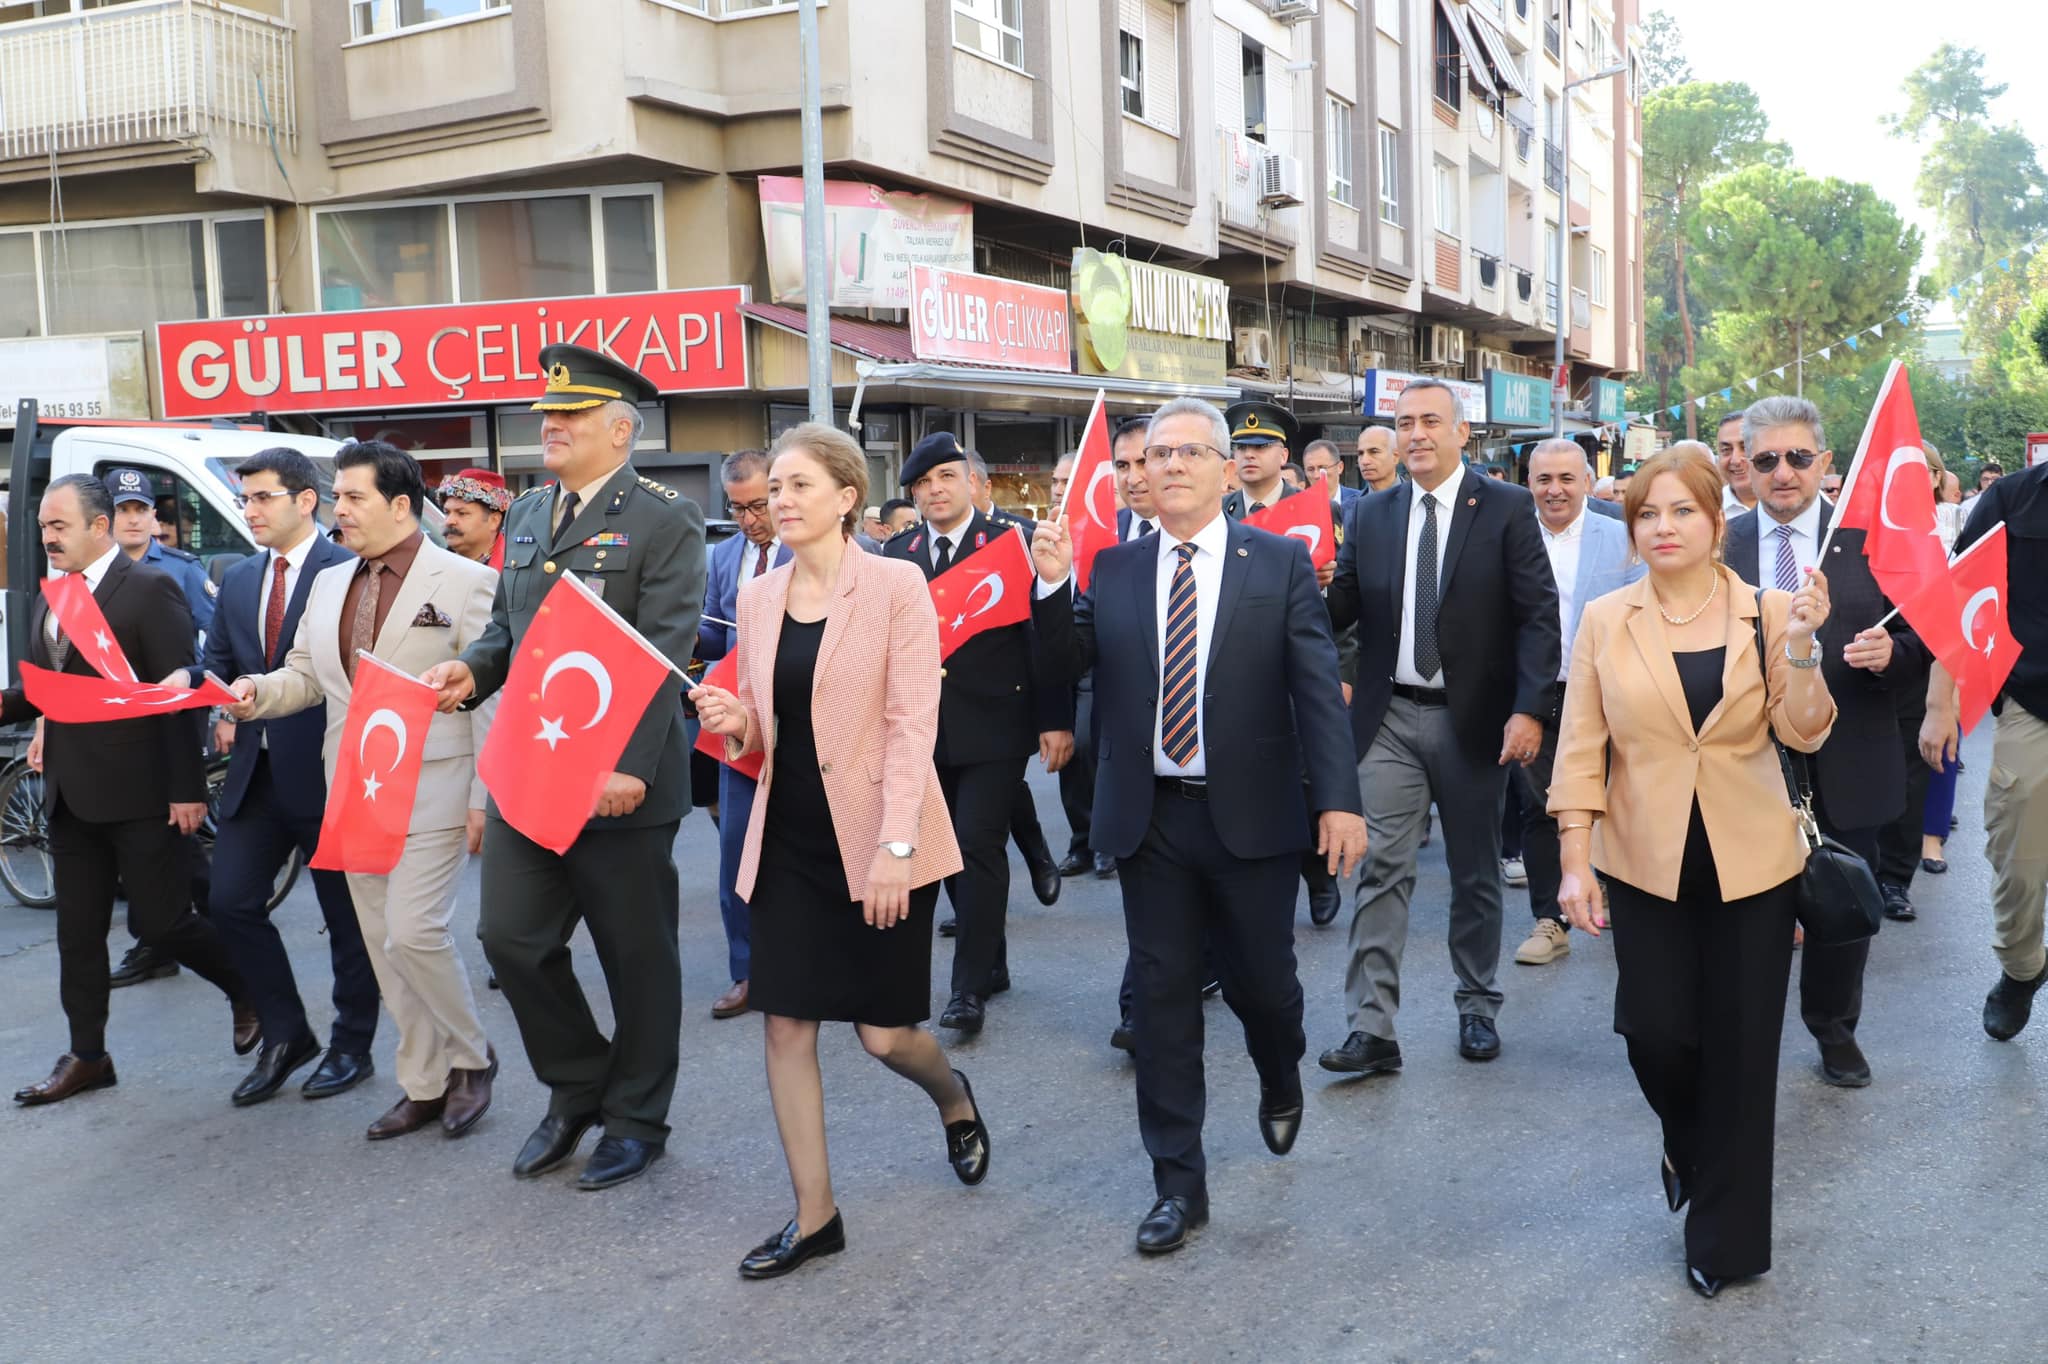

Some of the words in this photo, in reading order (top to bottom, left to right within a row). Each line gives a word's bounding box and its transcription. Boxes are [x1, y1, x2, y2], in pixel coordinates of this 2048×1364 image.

[921, 276, 990, 343] GÜLER
[994, 294, 1066, 357] ÇELİKKAPI
[1131, 265, 1232, 341] NUMUNE-TEK
[177, 319, 406, 400] GÜLER
[44, 403, 65, 418] 315
[69, 402, 83, 417] 93
[87, 401, 102, 416] 55
[1504, 380, 1529, 417] A-101
